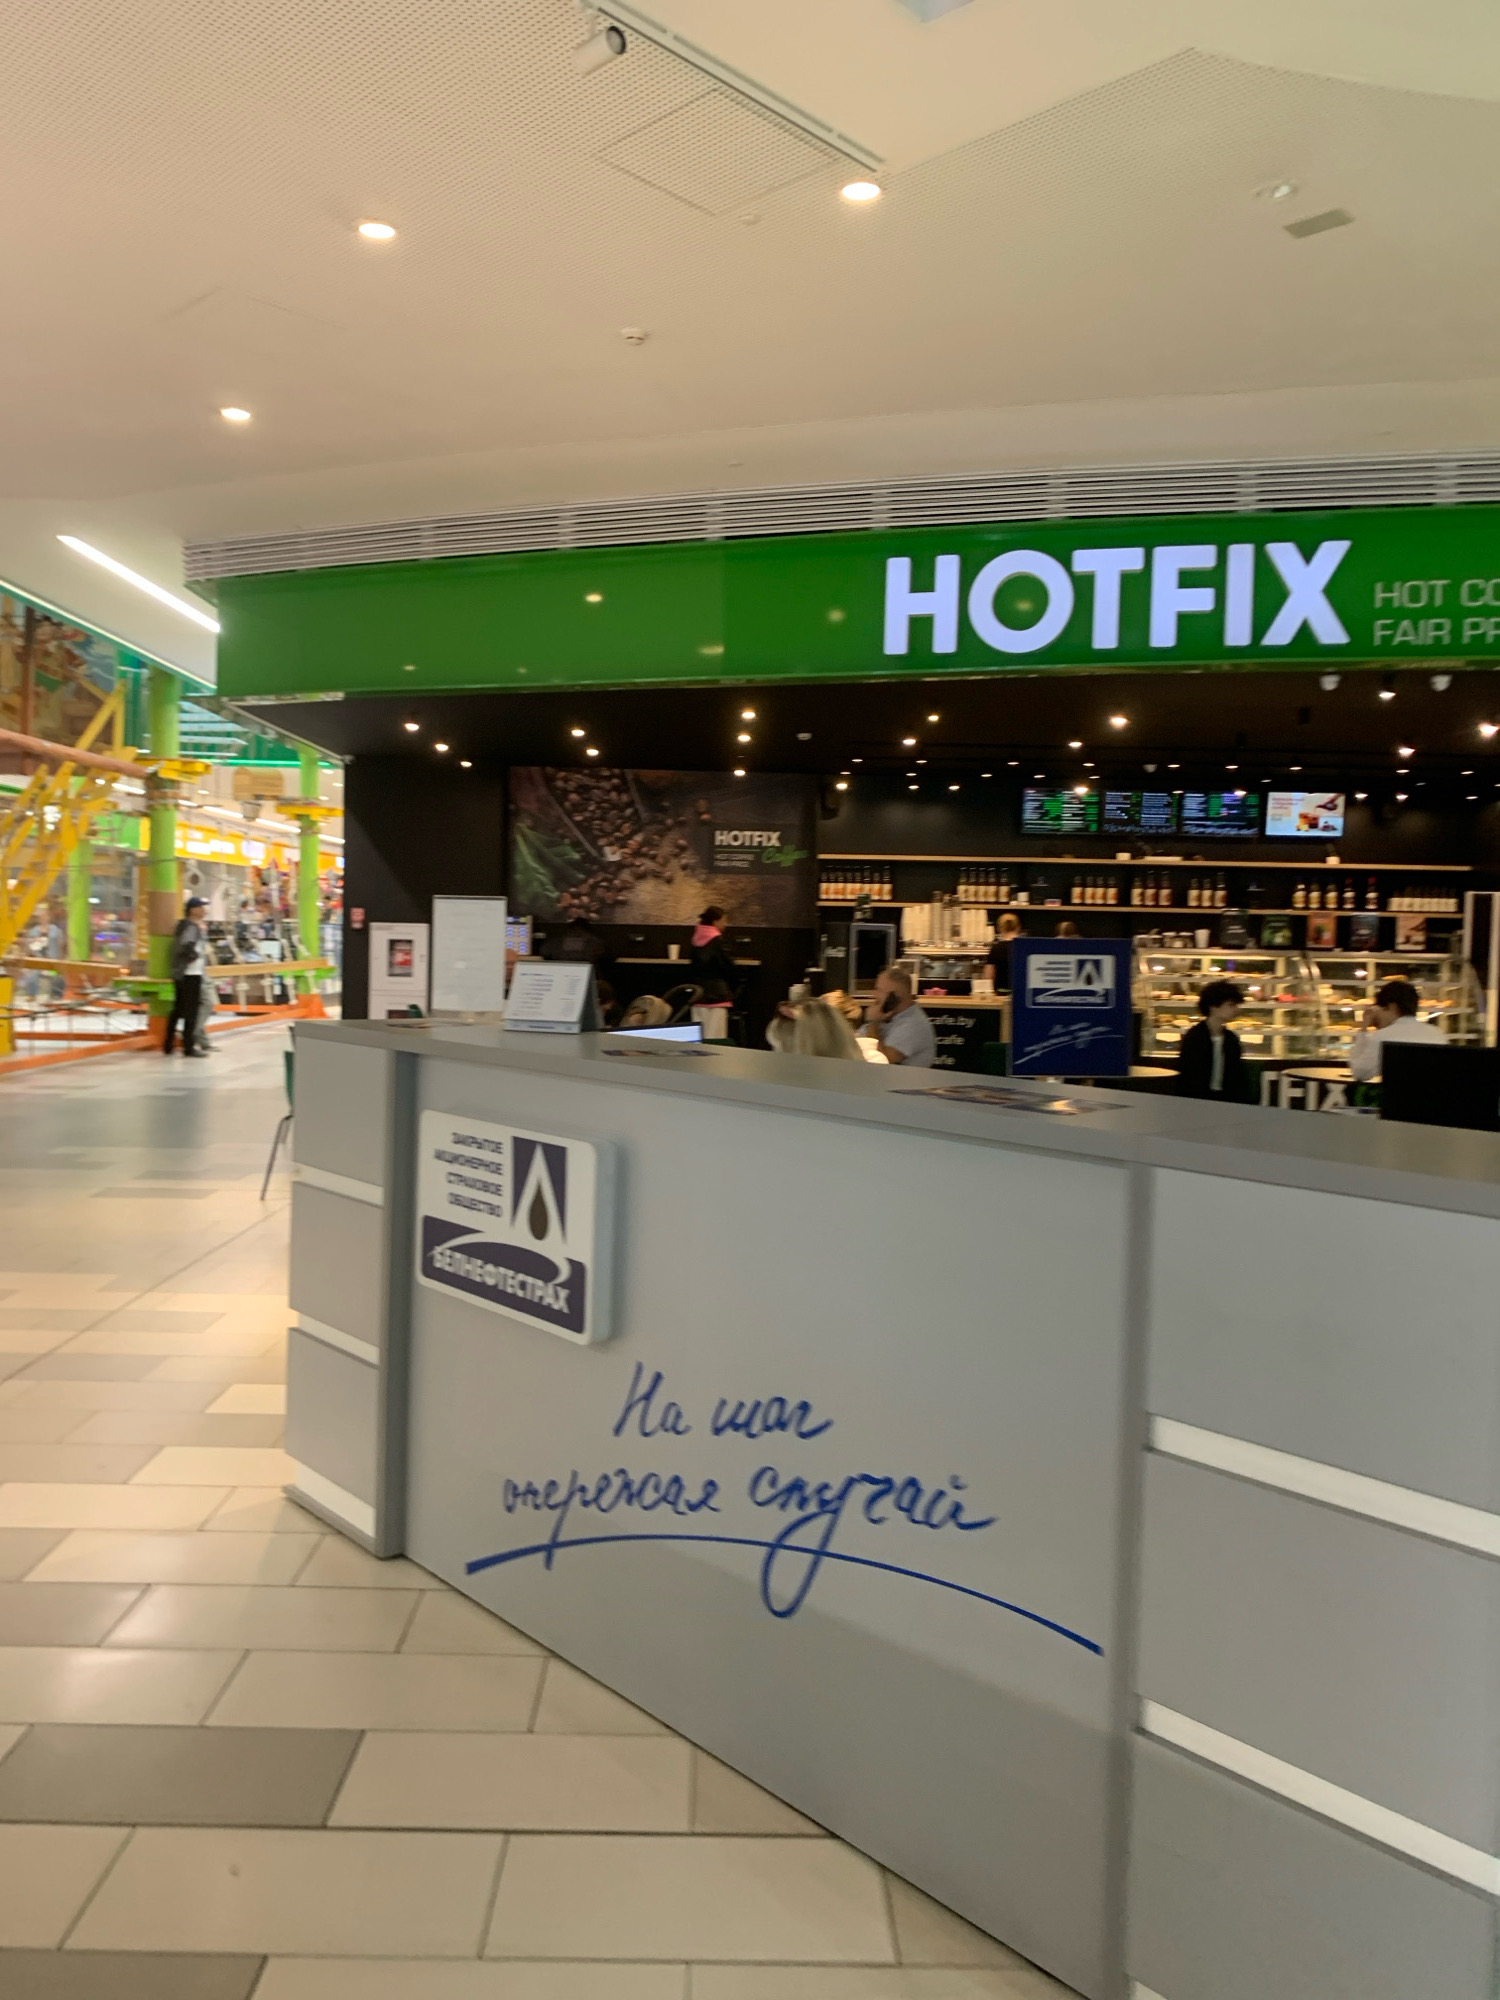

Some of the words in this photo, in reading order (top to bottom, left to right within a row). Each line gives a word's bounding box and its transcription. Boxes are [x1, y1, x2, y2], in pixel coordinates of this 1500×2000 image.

[884, 540, 1352, 656] HOTFIX
[1374, 580, 1451, 608] HOT
[1373, 619, 1451, 646] FAIR
[714, 830, 781, 847] HOTFIX
[446, 1171, 504, 1197] СТРАХОВОЕ
[447, 1192, 503, 1218] ОБЩЕСТВО
[432, 1245, 571, 1314] БЕЛНЕФТЕСТРАХ
[612, 1361, 692, 1438] На
[711, 1396, 834, 1440] шаг
